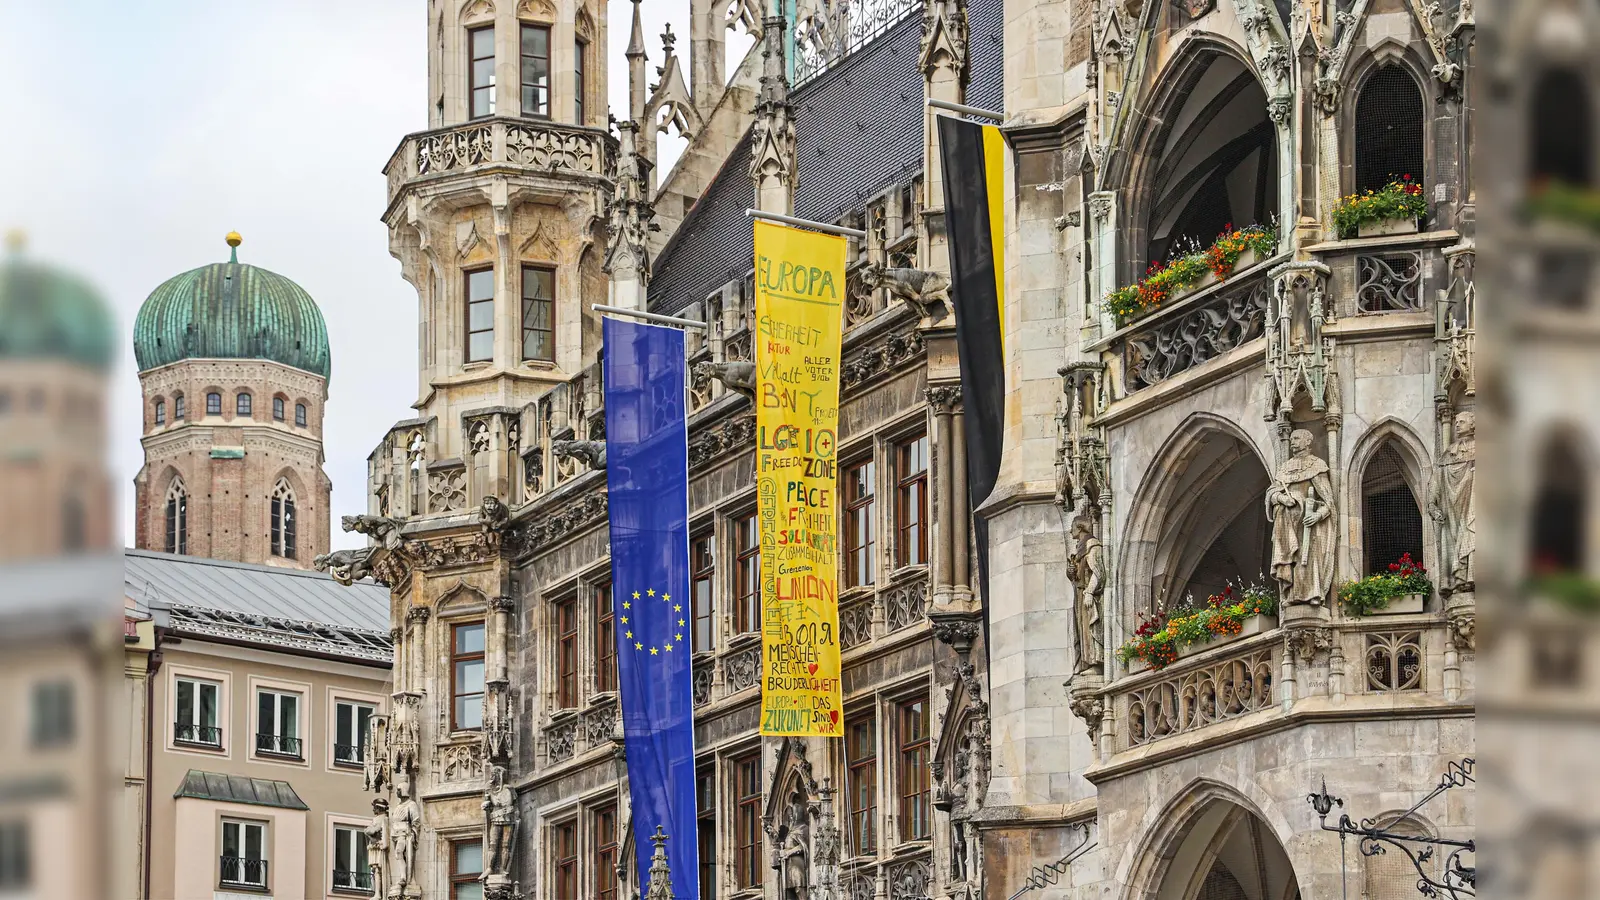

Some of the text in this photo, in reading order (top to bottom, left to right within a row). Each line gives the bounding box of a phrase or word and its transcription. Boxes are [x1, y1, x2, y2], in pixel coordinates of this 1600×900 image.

[758, 254, 836, 299] EUROPA
[761, 453, 835, 480] FREEDO ZONE
[787, 481, 829, 508] PEACE
[788, 507, 833, 532] FRIHEIT
[776, 575, 834, 604] UNION
[812, 696, 831, 710] DAS
[764, 708, 811, 732] ZUKUNFT
[812, 710, 831, 723] SIND
[817, 723, 834, 734] WIR
